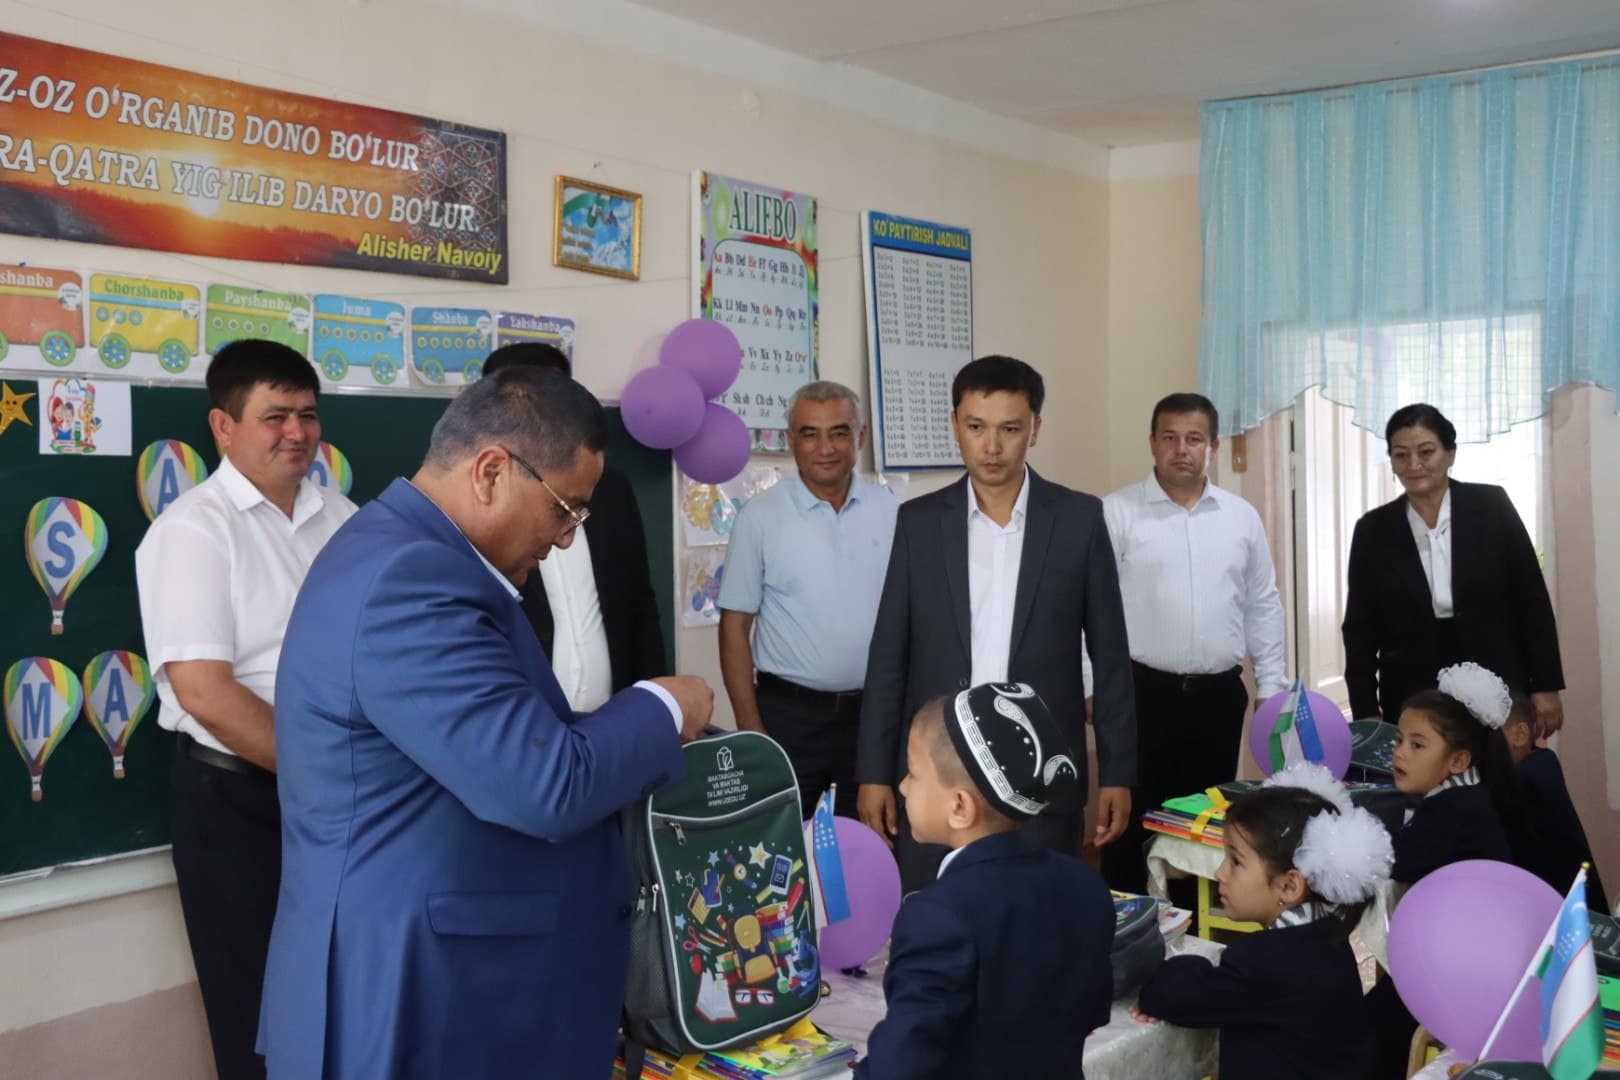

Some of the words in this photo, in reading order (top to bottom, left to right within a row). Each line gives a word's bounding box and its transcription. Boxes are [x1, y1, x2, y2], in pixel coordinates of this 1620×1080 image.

[85, 83, 236, 141] O'RGANIB
[242, 115, 321, 155] DONO
[328, 129, 420, 172] BO'LUR
[292, 181, 383, 221] DARYO
[729, 191, 797, 241] ALIFBO
[357, 232, 432, 263] Alisher
[436, 241, 502, 275] Navoiy
[104, 279, 185, 302] Chorshanba
[44, 520, 76, 580] S
[22, 681, 50, 742] M
[103, 667, 129, 724] A
